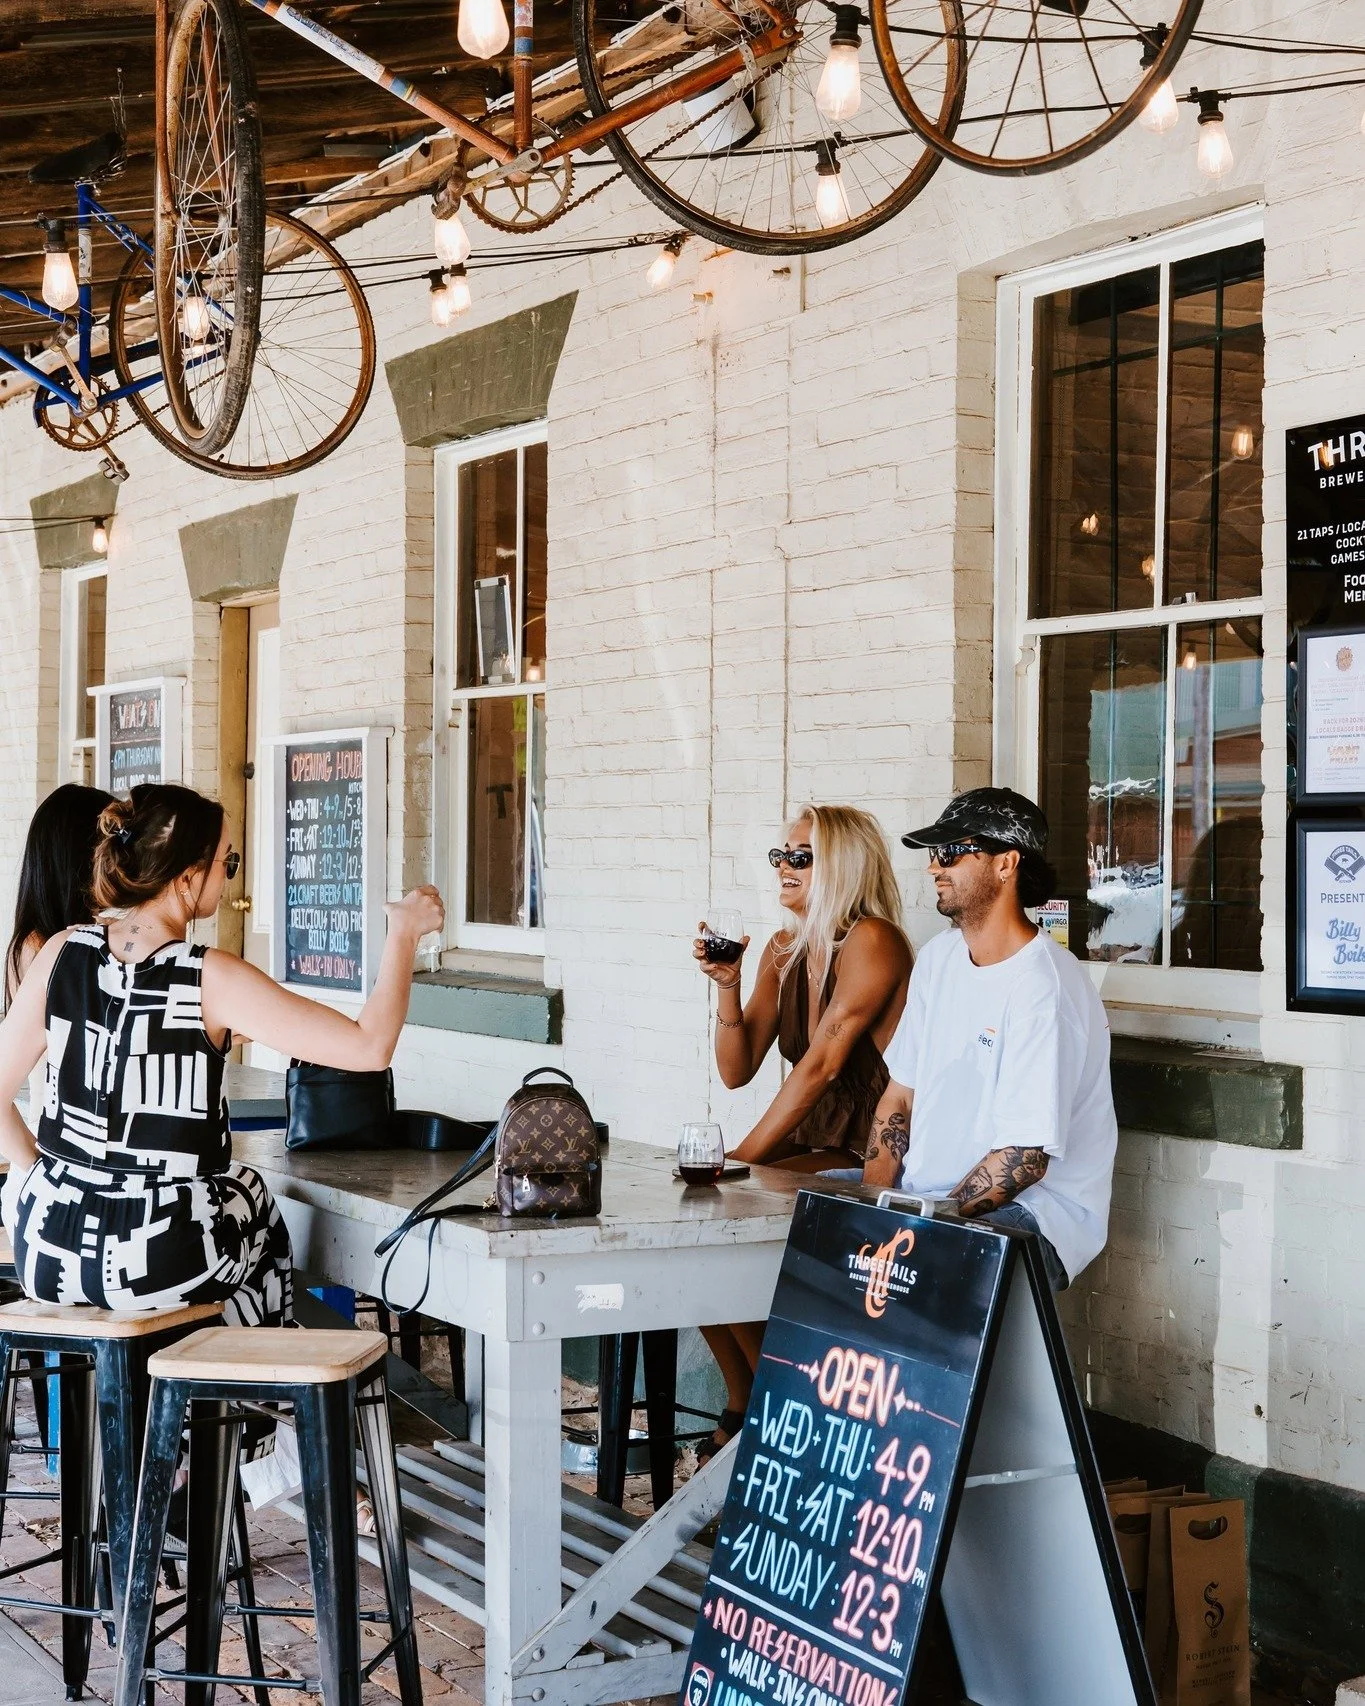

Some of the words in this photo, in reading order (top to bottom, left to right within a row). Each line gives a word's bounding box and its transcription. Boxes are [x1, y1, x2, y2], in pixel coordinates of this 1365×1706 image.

[1320, 470, 1364, 489] BREWE
[1297, 529, 1308, 540] 21
[1310, 526, 1334, 538] TAPS
[291, 751, 333, 782] OPENING
[297, 884, 319, 905] CRAFT
[319, 883, 341, 905] BEERS
[342, 883, 353, 905] ON
[290, 908, 328, 930] DELICIOUS
[330, 909, 349, 932] FOOD
[1326, 918, 1361, 942] Billy
[308, 928, 328, 951] BILLY
[329, 930, 350, 953] BOILS
[333, 955, 356, 981] ONLY
[848, 1254, 886, 1273] THREE
[886, 1260, 918, 1285] TAILS
[817, 1346, 900, 1428] OPEN
[712, 1597, 748, 1641] NO
